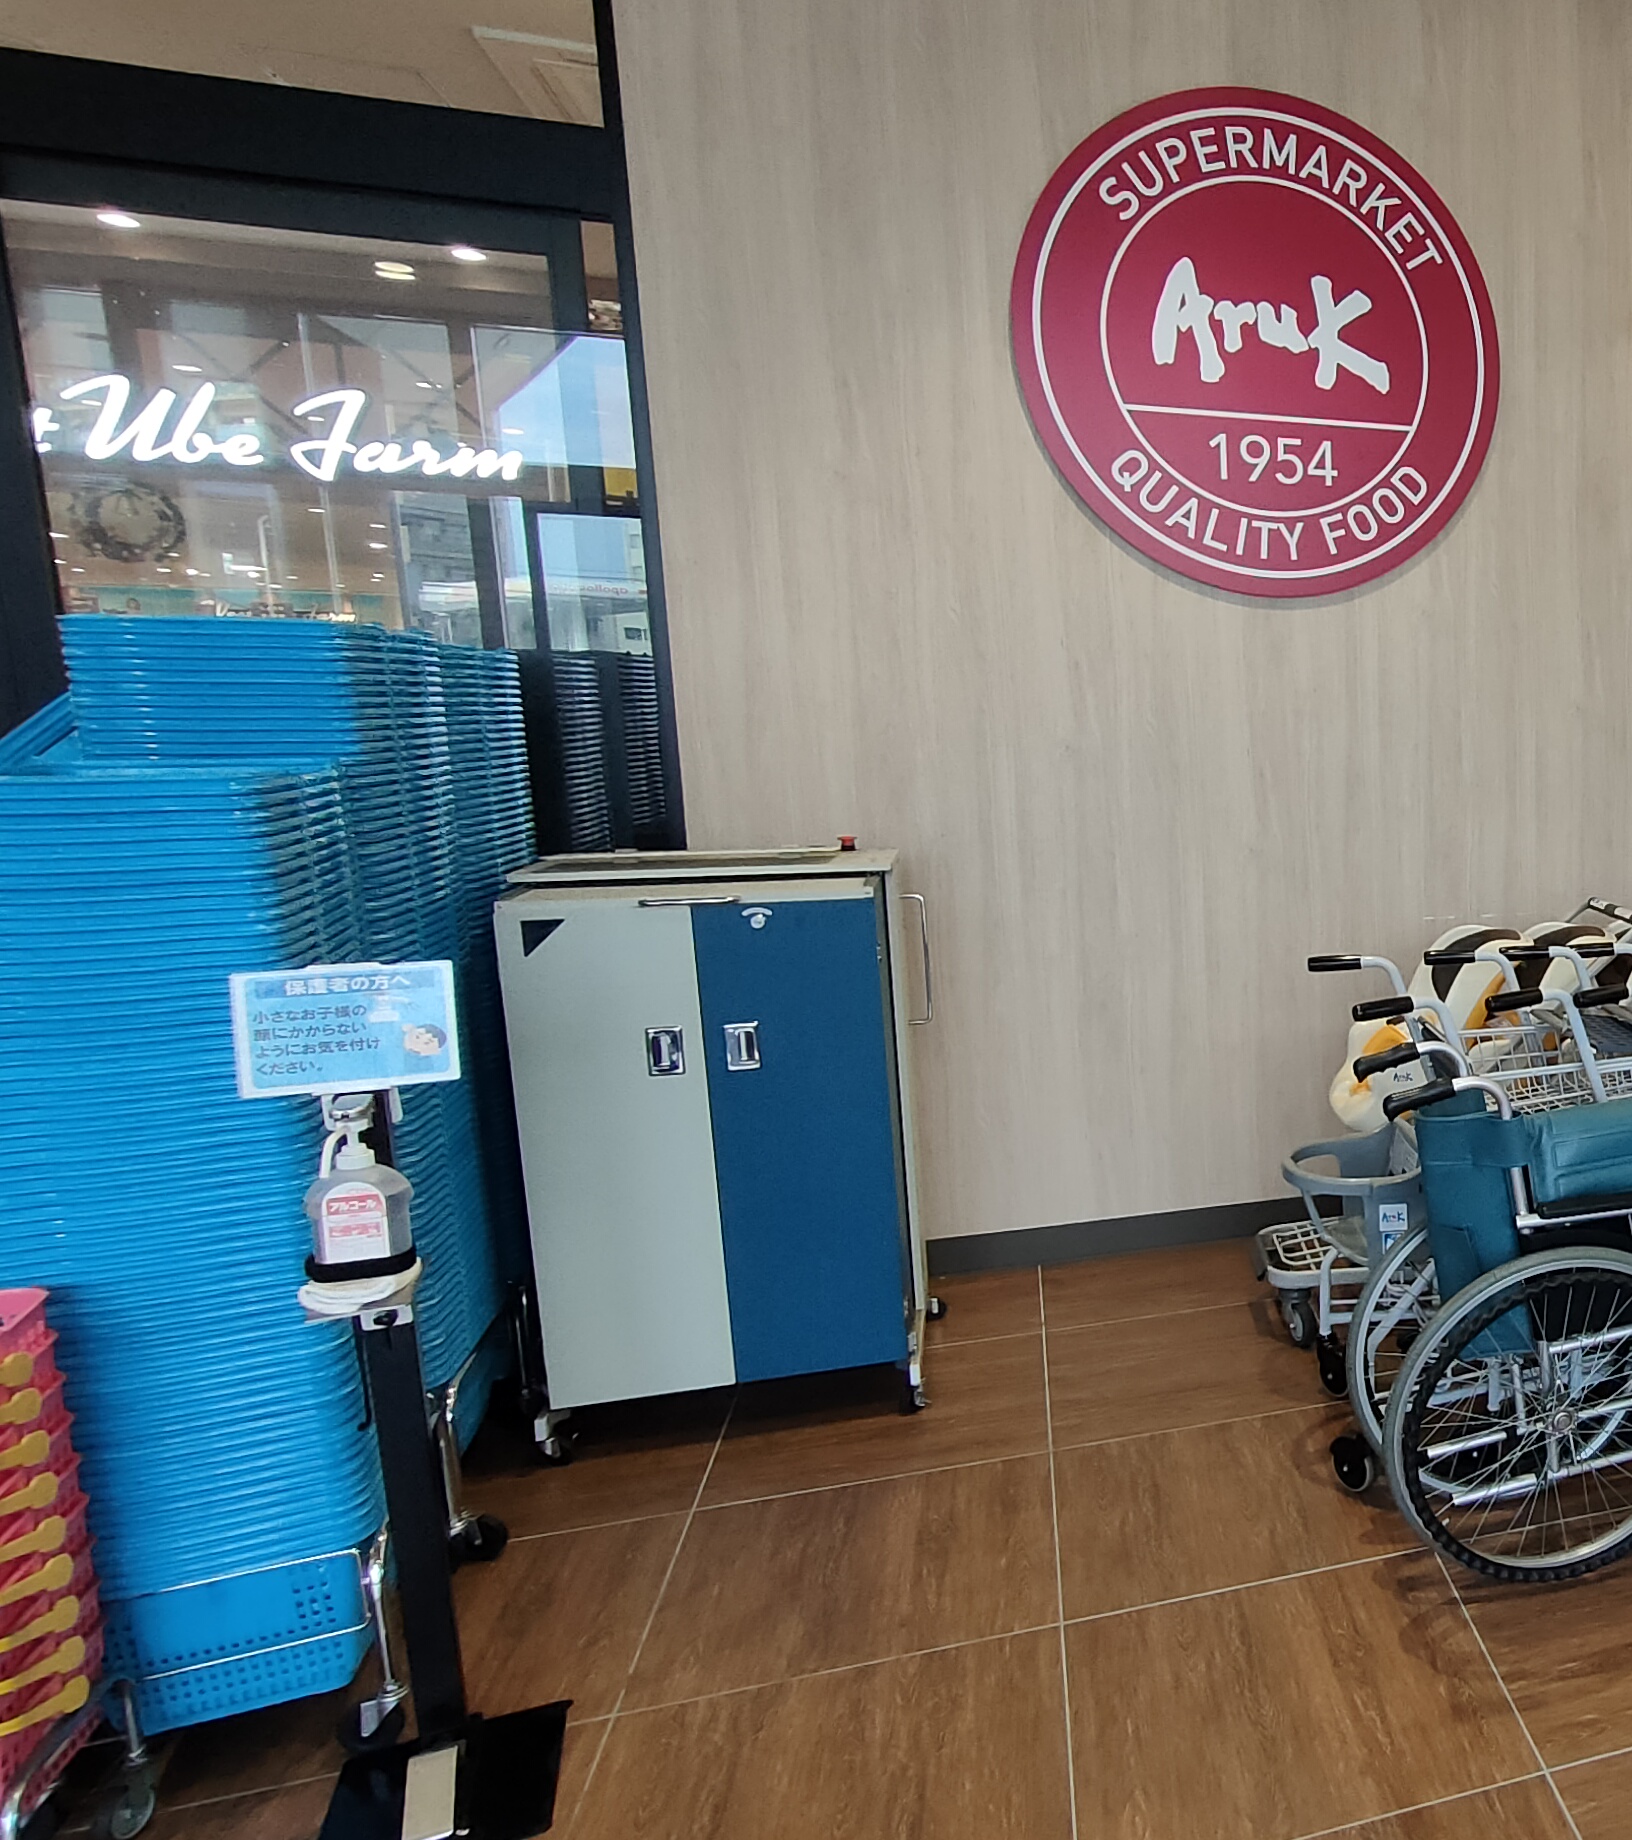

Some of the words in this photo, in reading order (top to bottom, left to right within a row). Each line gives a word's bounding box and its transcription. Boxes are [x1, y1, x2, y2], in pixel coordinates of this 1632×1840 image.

[1099, 126, 1442, 271] SUPERMARKET
[60, 374, 265, 466] Ube
[290, 389, 524, 482] Farm
[1209, 433, 1338, 486] 1954
[1111, 449, 1304, 560] QUALITY
[1321, 465, 1428, 555] FOOD
[284, 975, 411, 996] 保護者の方へ
[253, 1004, 367, 1024] 小さなお子様の
[256, 1038, 381, 1059] ようにお気を付け
[256, 1061, 323, 1076] ください。
[328, 1199, 377, 1213] アルコール
